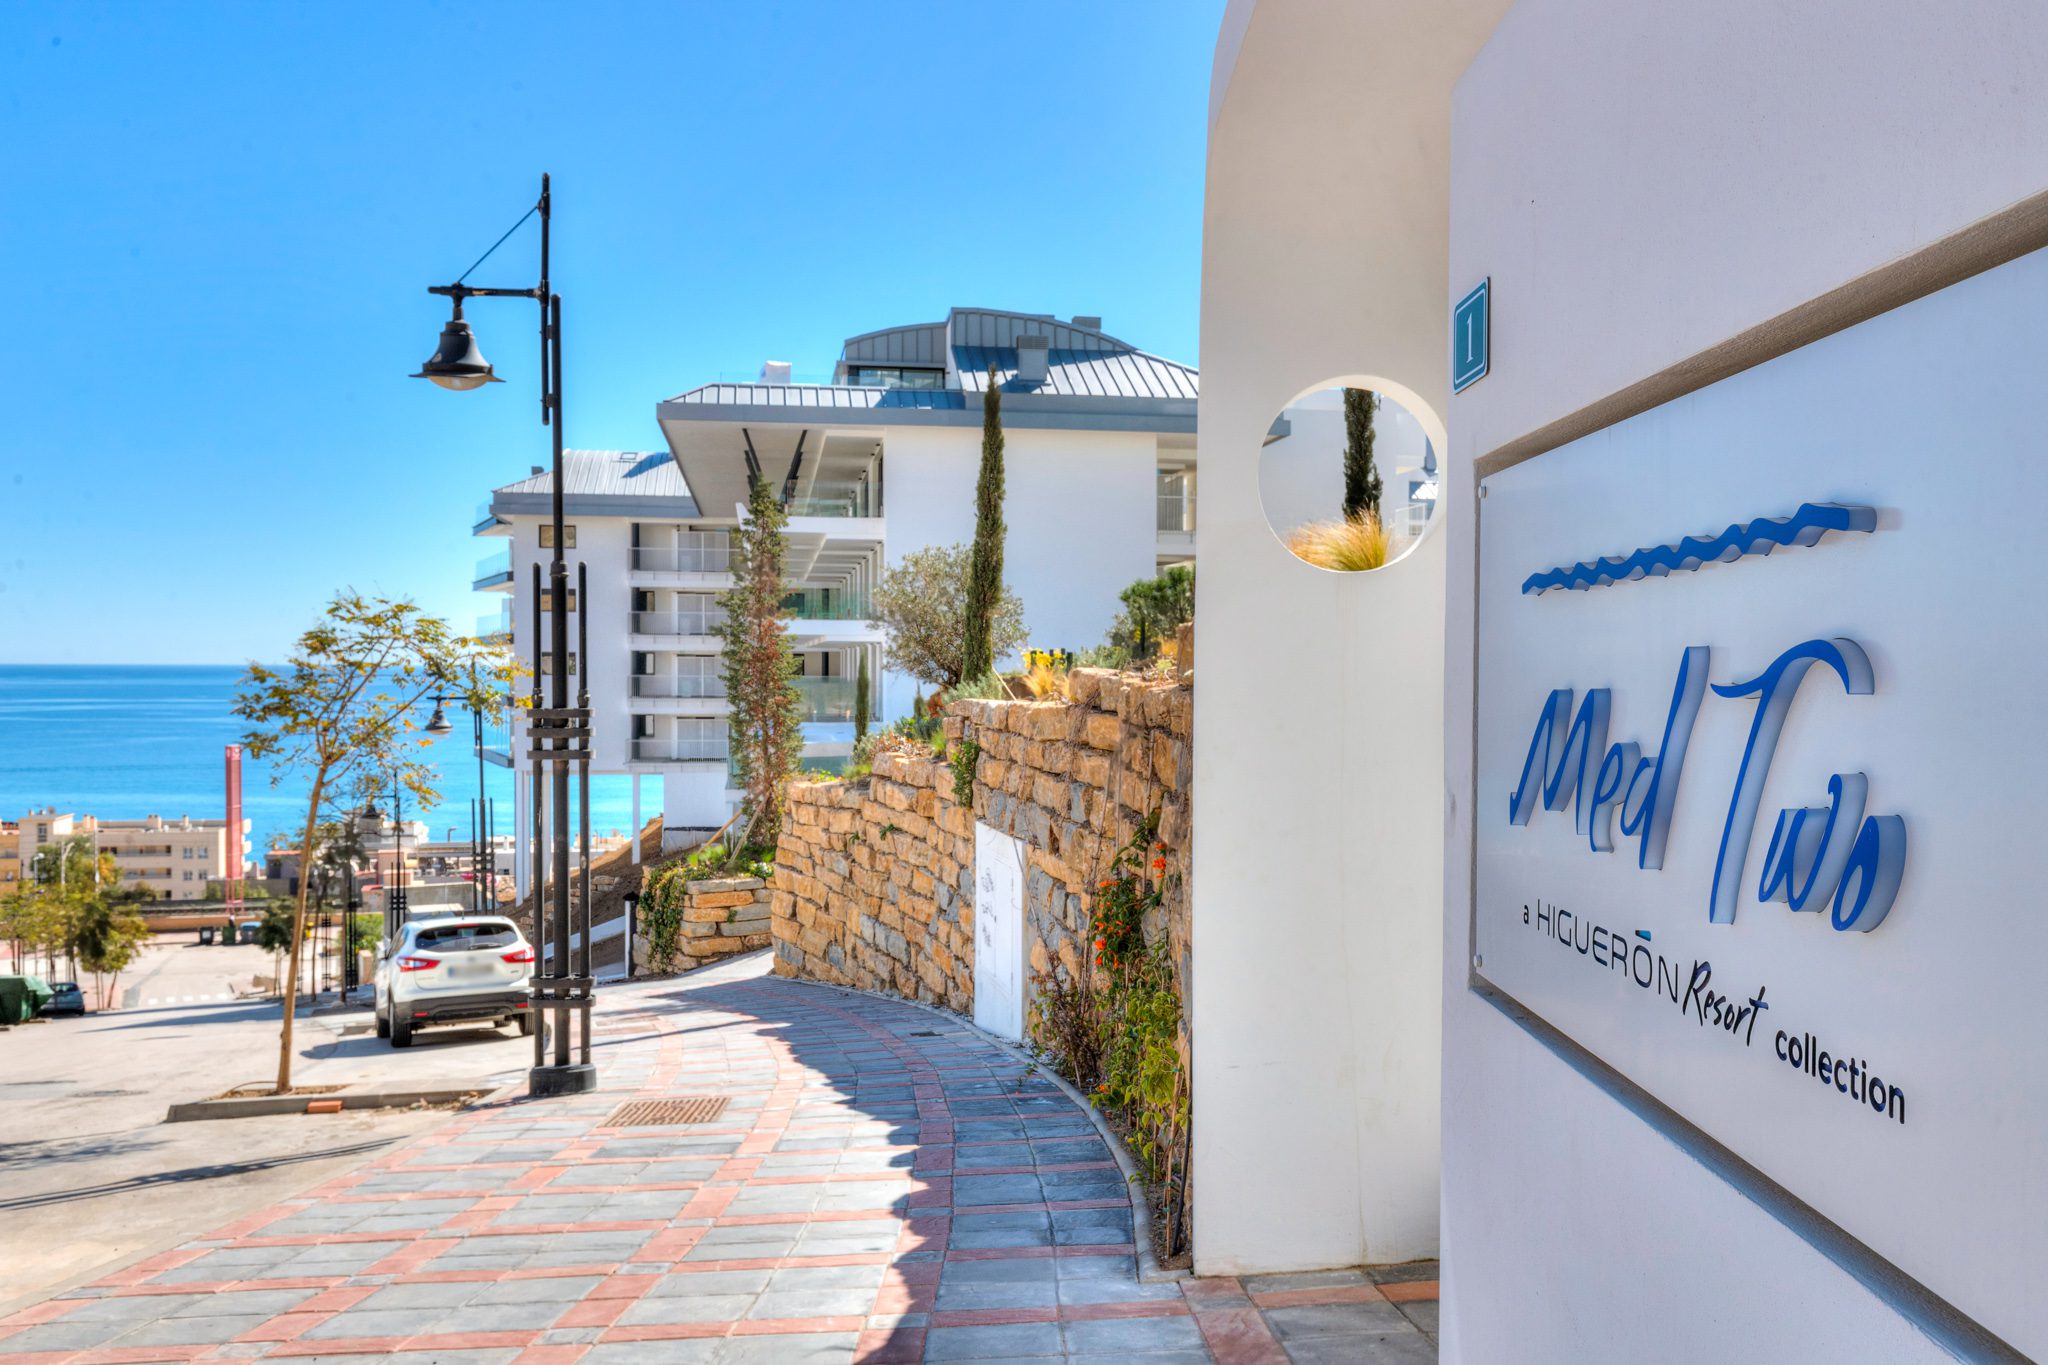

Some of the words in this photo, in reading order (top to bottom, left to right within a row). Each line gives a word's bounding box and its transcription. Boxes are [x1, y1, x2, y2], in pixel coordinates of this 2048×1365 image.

[1466, 312, 1473, 363] 1
[1510, 645, 1709, 870] Med
[1711, 637, 1907, 933] Two
[1523, 904, 1530, 925] a
[1682, 959, 1769, 1047] Resort
[1775, 1029, 1905, 1125] collection
